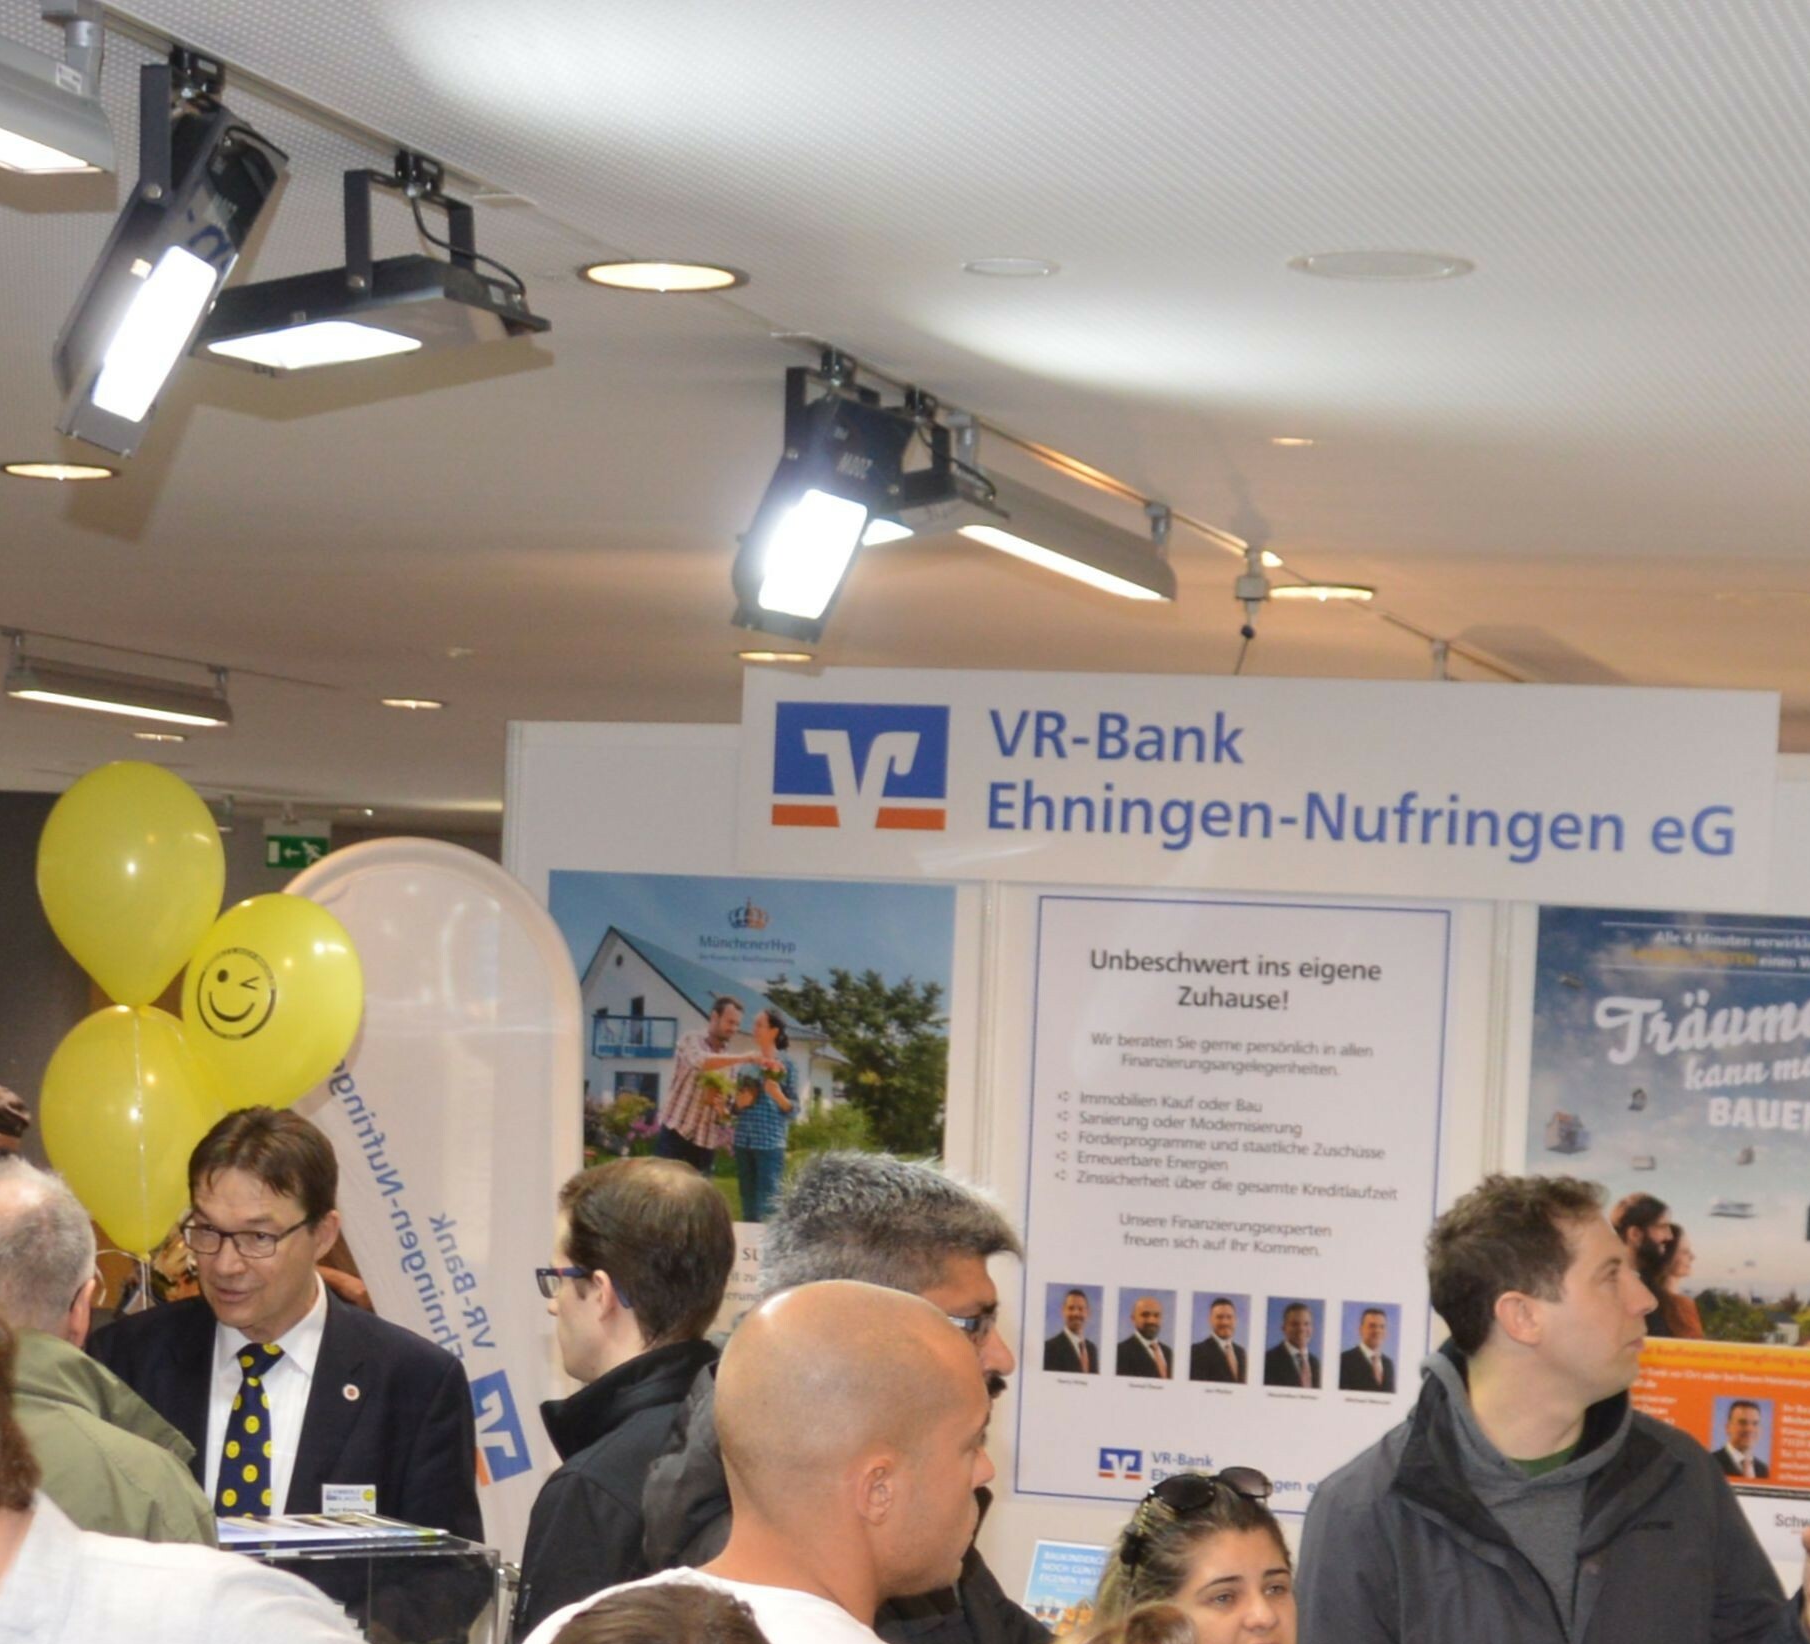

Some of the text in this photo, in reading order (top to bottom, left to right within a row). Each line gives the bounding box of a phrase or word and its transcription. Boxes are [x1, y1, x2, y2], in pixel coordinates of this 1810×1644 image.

[989, 710, 1244, 765] VR-Bank
[986, 782, 1736, 865] Ehningen-Nufringen eG
[1090, 949, 1382, 985] Unbeschwert ins eigene
[1177, 985, 1290, 1010] Zuhause!
[1091, 1032, 1112, 1048] Wir
[1117, 1033, 1173, 1050] beraten
[1176, 1035, 1197, 1051] Sie
[1246, 1038, 1319, 1059] persönlich
[1322, 1043, 1336, 1057] in
[1339, 1043, 1374, 1058] allen
[1684, 1053, 1770, 1091] kann
[1079, 1091, 1263, 1113] Immobilien Kauf oder Bau
[1078, 1111, 1303, 1140] Sanierung oder Modernisierung
[1078, 1130, 1387, 1161] Förderprogramme und staatliche Zuschüsse
[1076, 1150, 1229, 1174] Erneuerbare Energien
[1075, 1170, 1399, 1201] Zinssicherheit über die gesamte Kreditlaufzeit
[1119, 1212, 1333, 1240] Unsere Finanzierungsexperten
[1122, 1232, 1321, 1259] freuen sich auf Ihr Kommen.
[1150, 1451, 1214, 1469] VR-Bank
